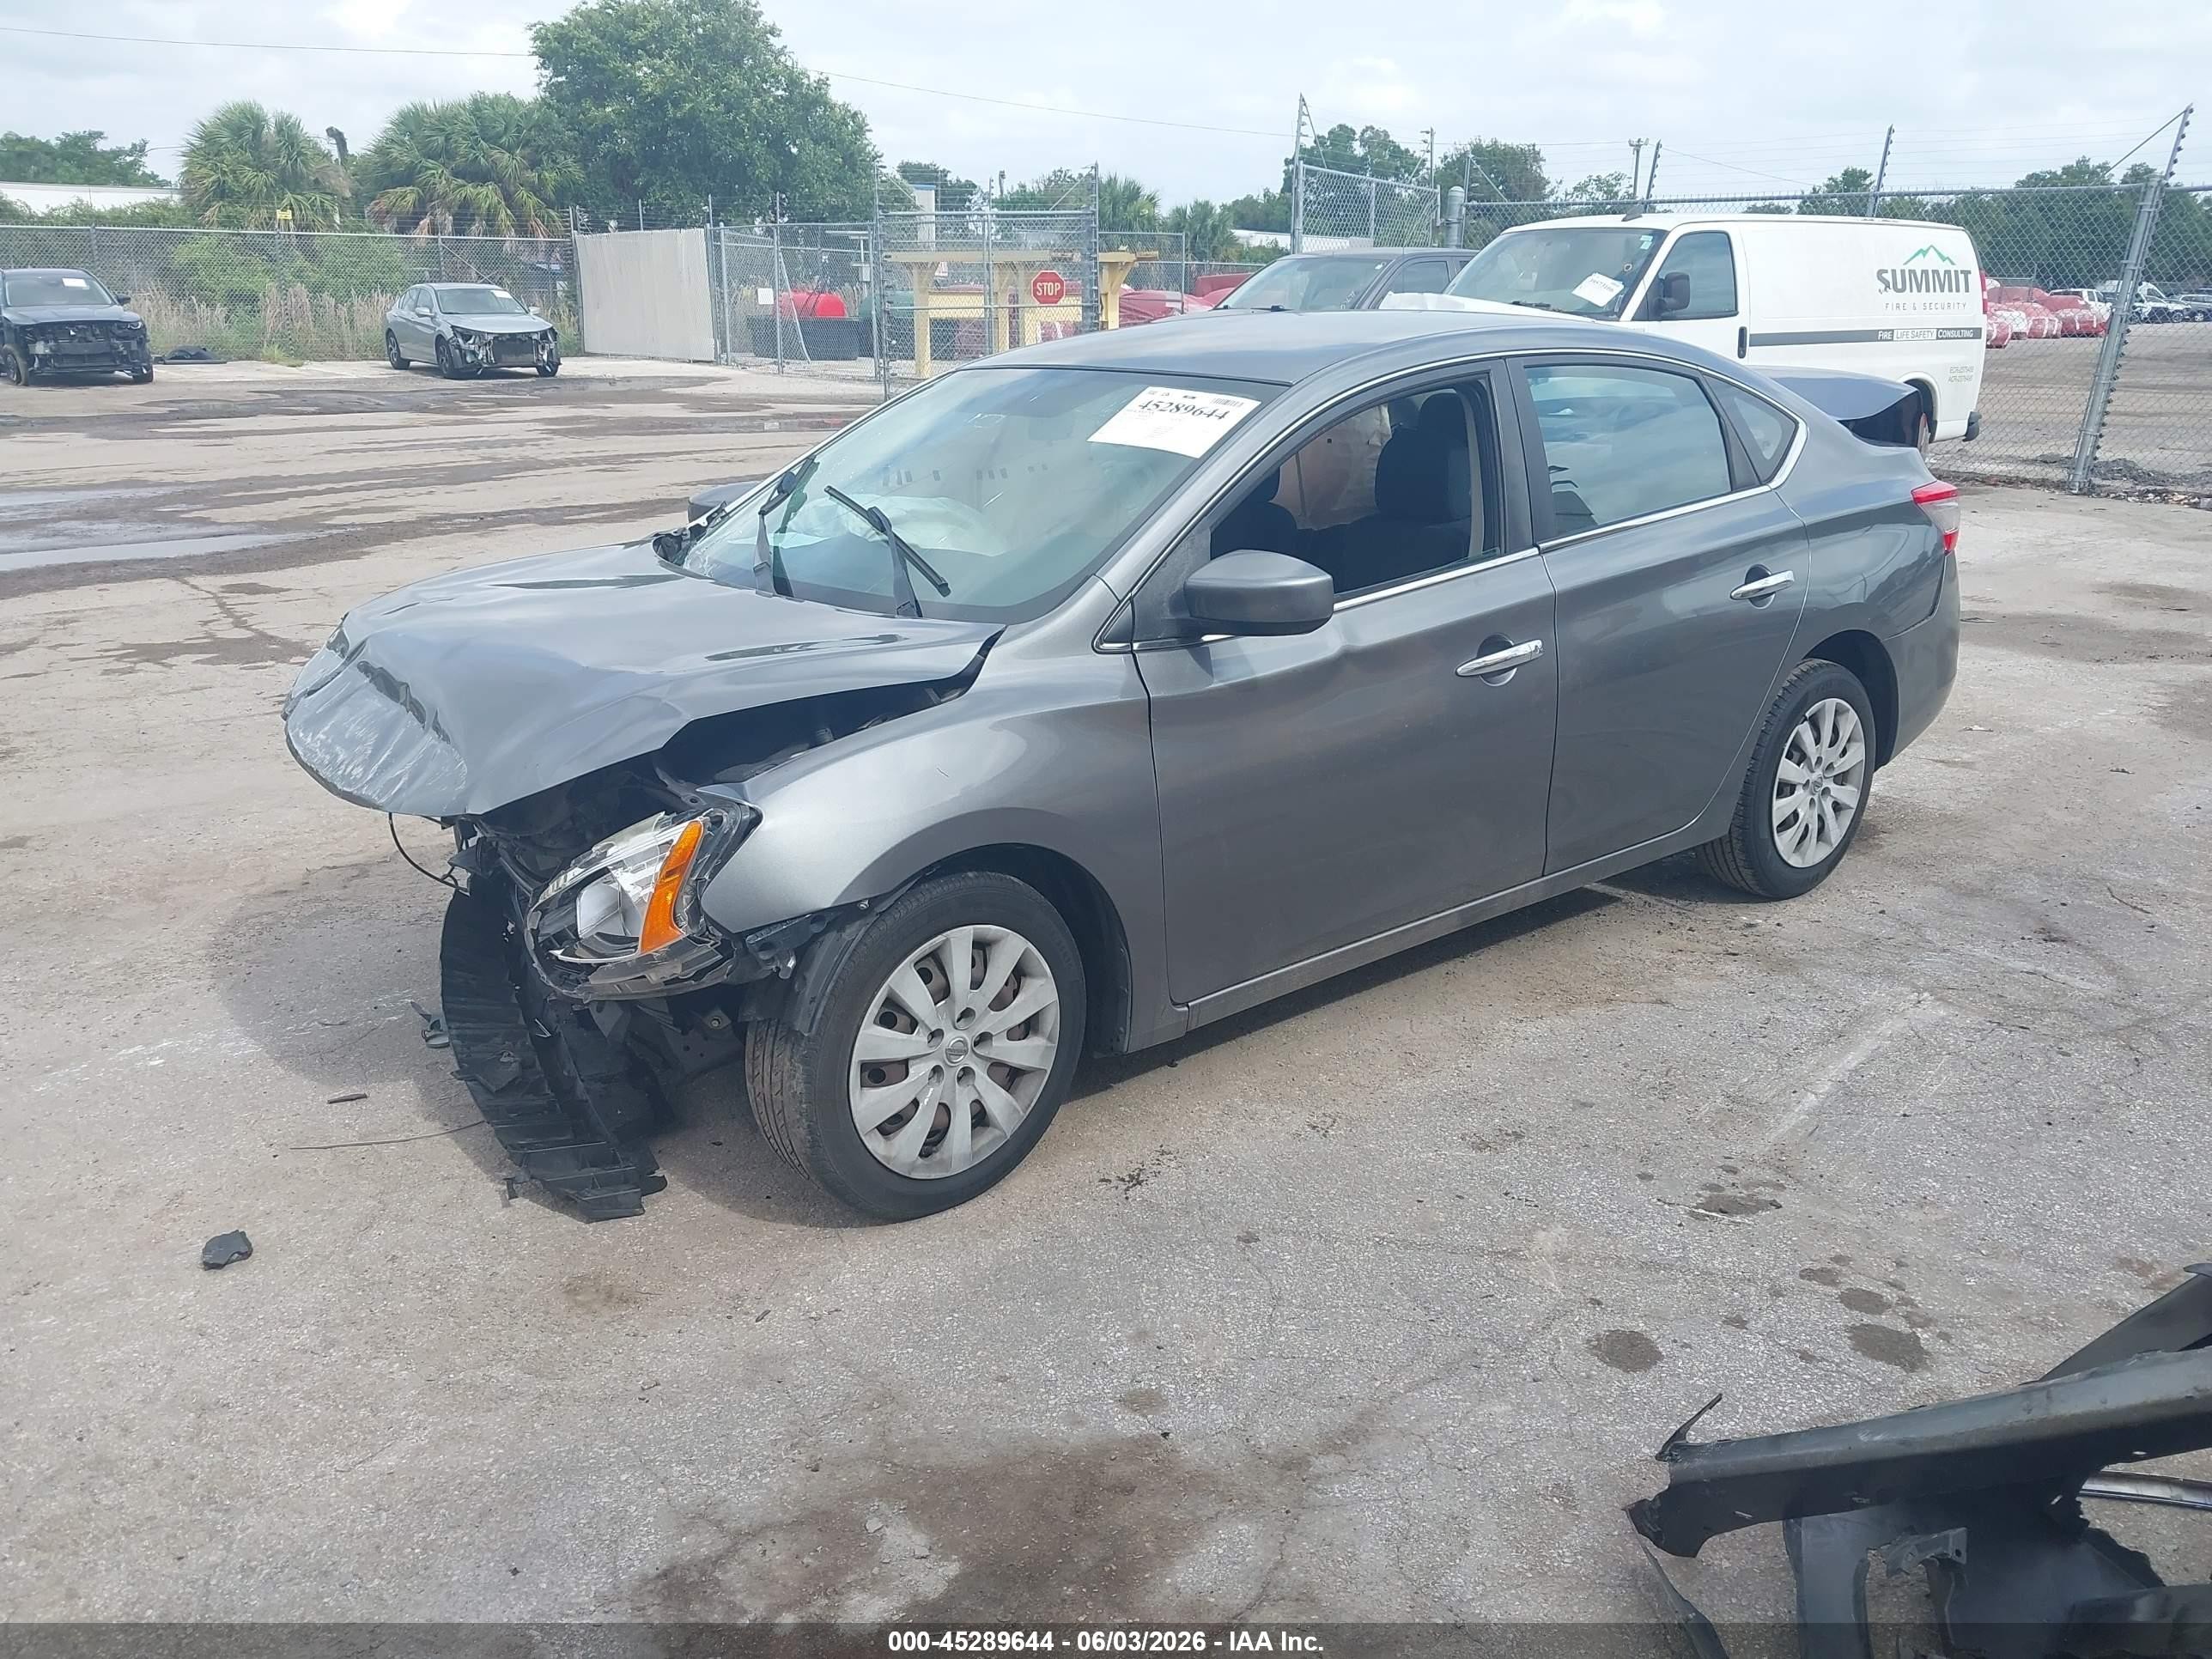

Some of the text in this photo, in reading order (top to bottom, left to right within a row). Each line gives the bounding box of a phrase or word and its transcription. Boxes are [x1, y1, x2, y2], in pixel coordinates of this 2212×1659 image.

[1036, 282, 1061, 296] STOP
[1876, 269, 1972, 294] SUMMIT
[1878, 329, 1973, 340] FIRE LIFE SAFETY CONSULTING
[1139, 399, 1231, 420] 45289644
